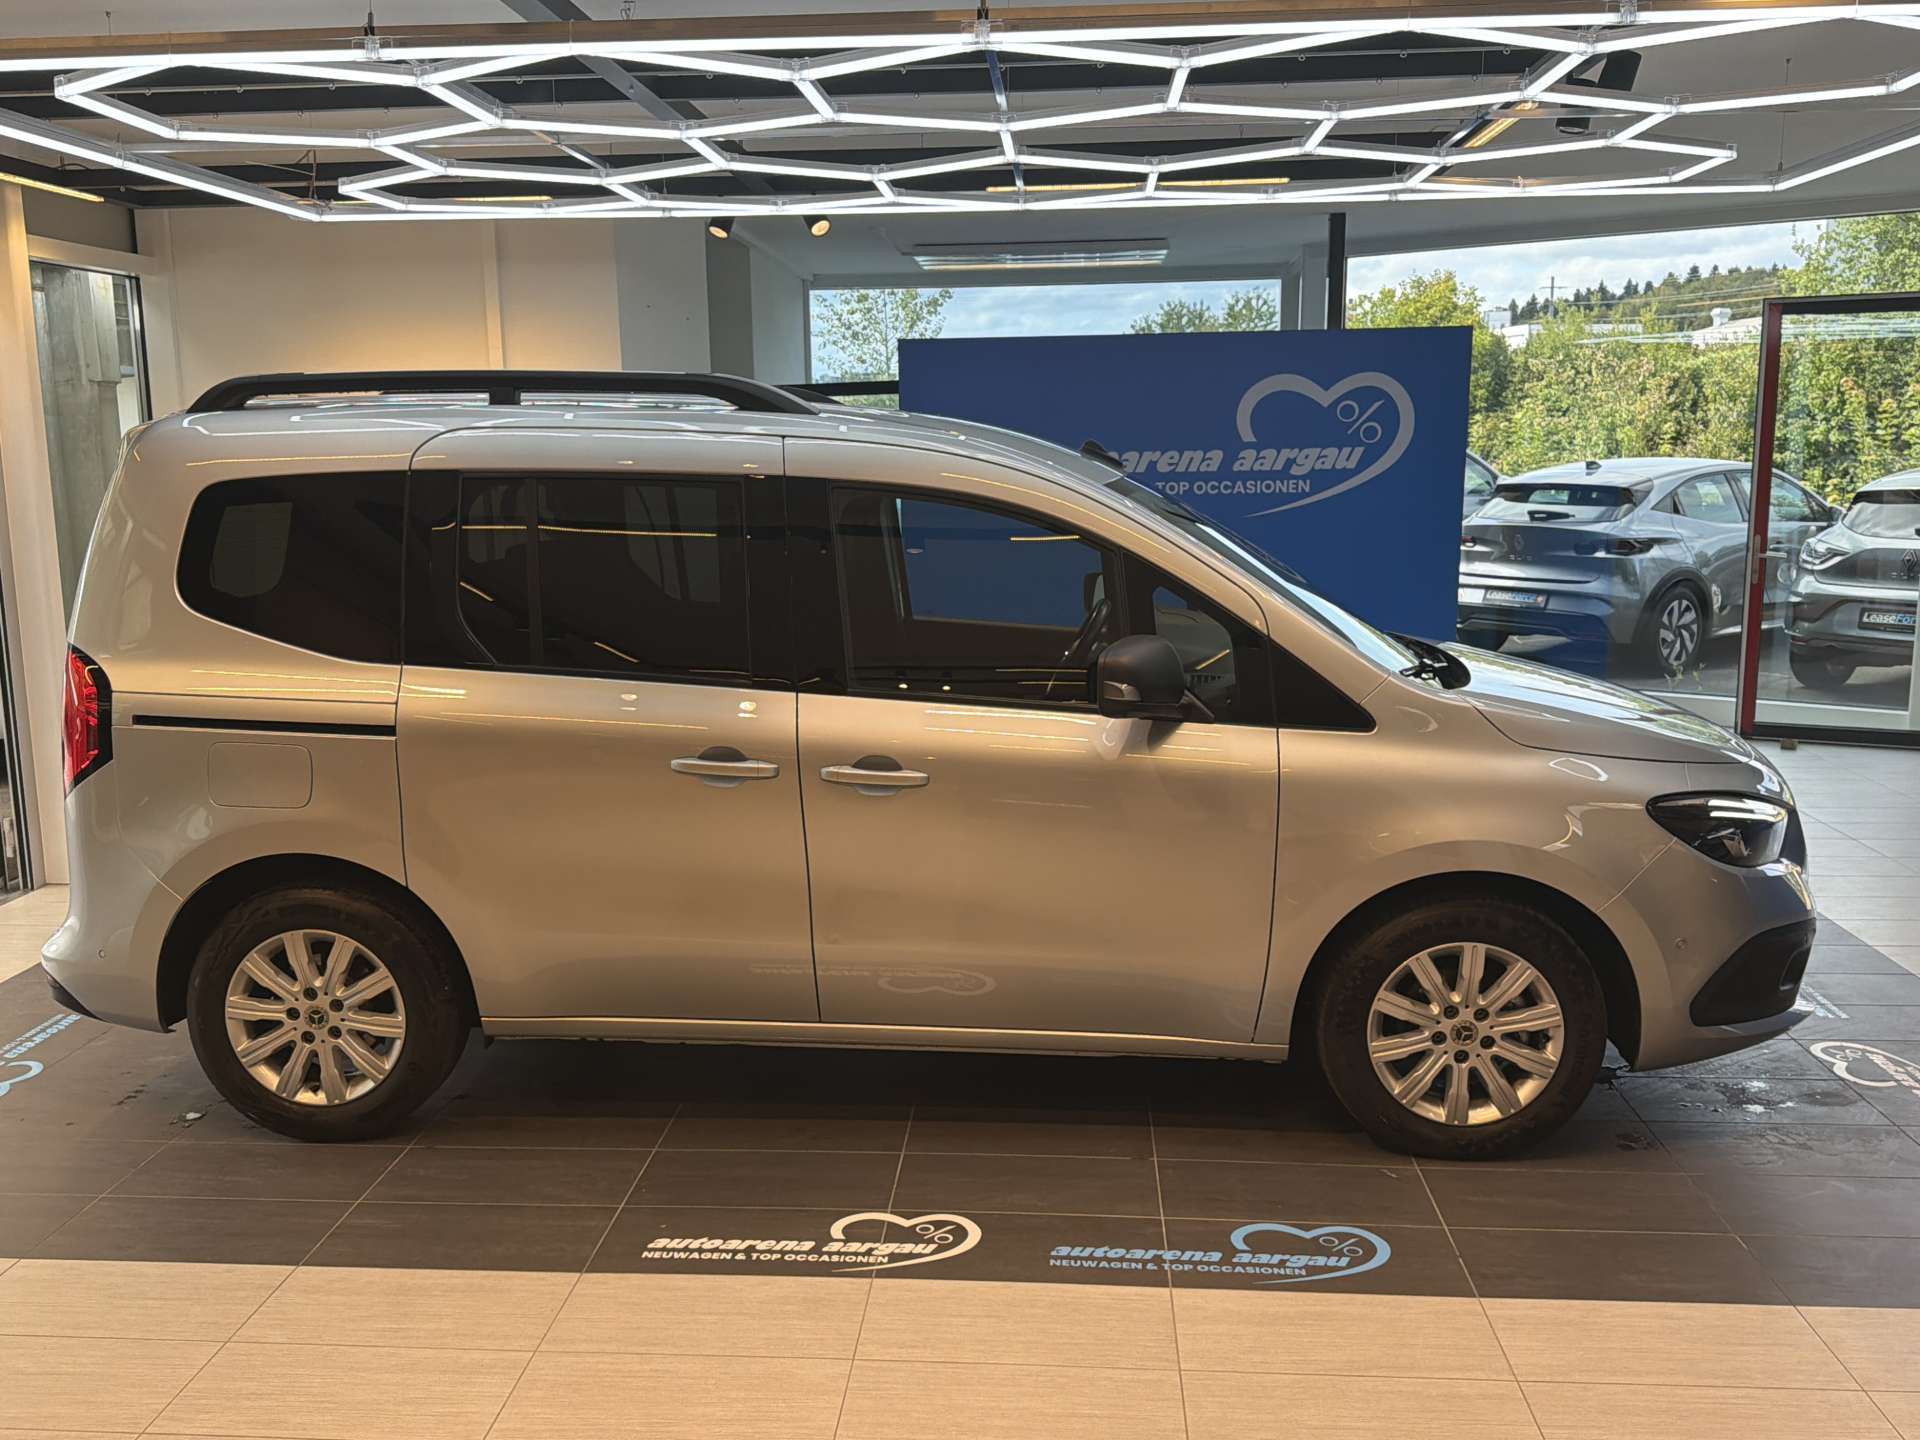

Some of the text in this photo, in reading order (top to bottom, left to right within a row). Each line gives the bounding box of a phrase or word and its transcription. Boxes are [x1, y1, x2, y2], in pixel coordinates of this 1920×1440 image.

[1232, 446, 1365, 475] aargau
[1193, 479, 1311, 495] OCCASIONEN
[647, 1236, 939, 1255] autoarena aargau
[641, 1251, 889, 1264] NEUWAGEN & TOP OCCASIONEN
[1050, 1245, 1353, 1268] autoarena aargau
[1050, 1259, 1143, 1270] NEUWAGEN
[1162, 1262, 1195, 1273] TOP
[1199, 1264, 1308, 1276] OCCASIONEN
